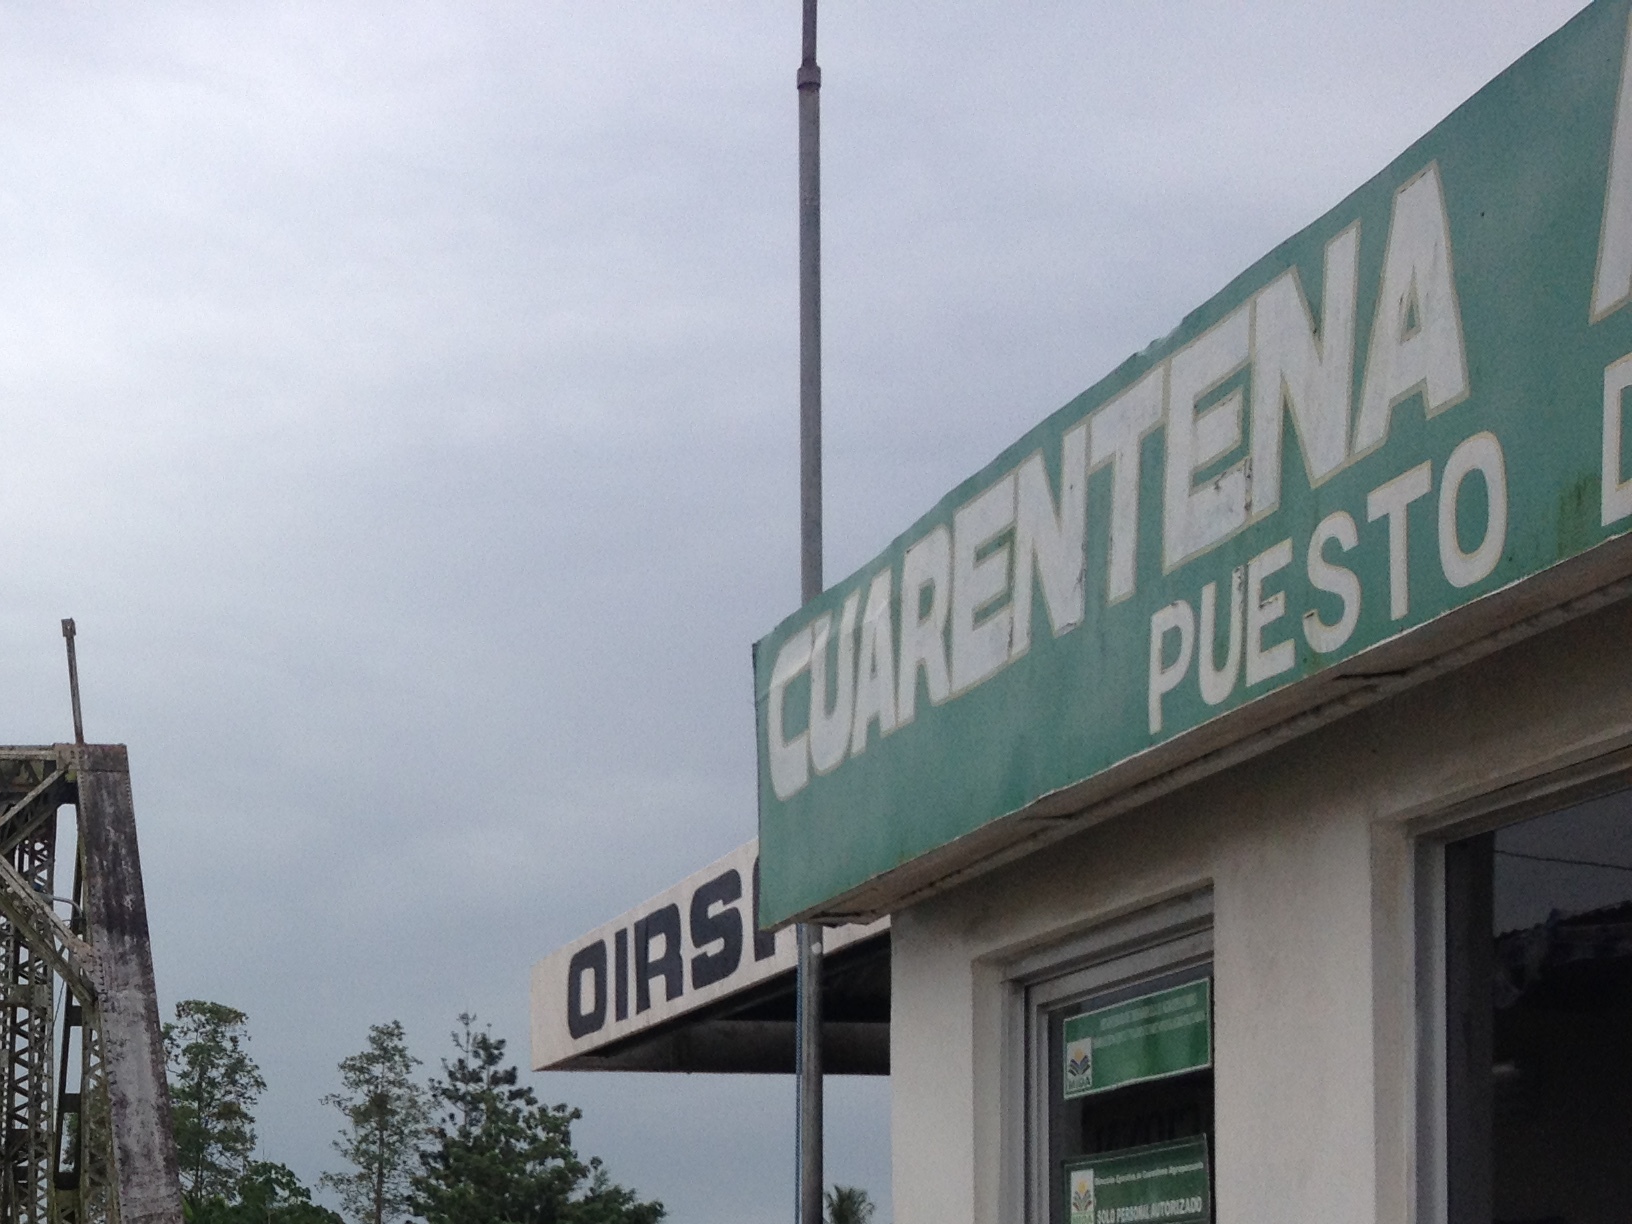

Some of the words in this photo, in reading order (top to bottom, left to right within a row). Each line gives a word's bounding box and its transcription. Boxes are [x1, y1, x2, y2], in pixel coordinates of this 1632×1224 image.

[767, 159, 1470, 800] CUARENTENA
[1147, 430, 1509, 735] PUESTO
[1116, 1203, 1150, 1224] PERSONAL
[1150, 1196, 1203, 1219] AUTORIZADO
